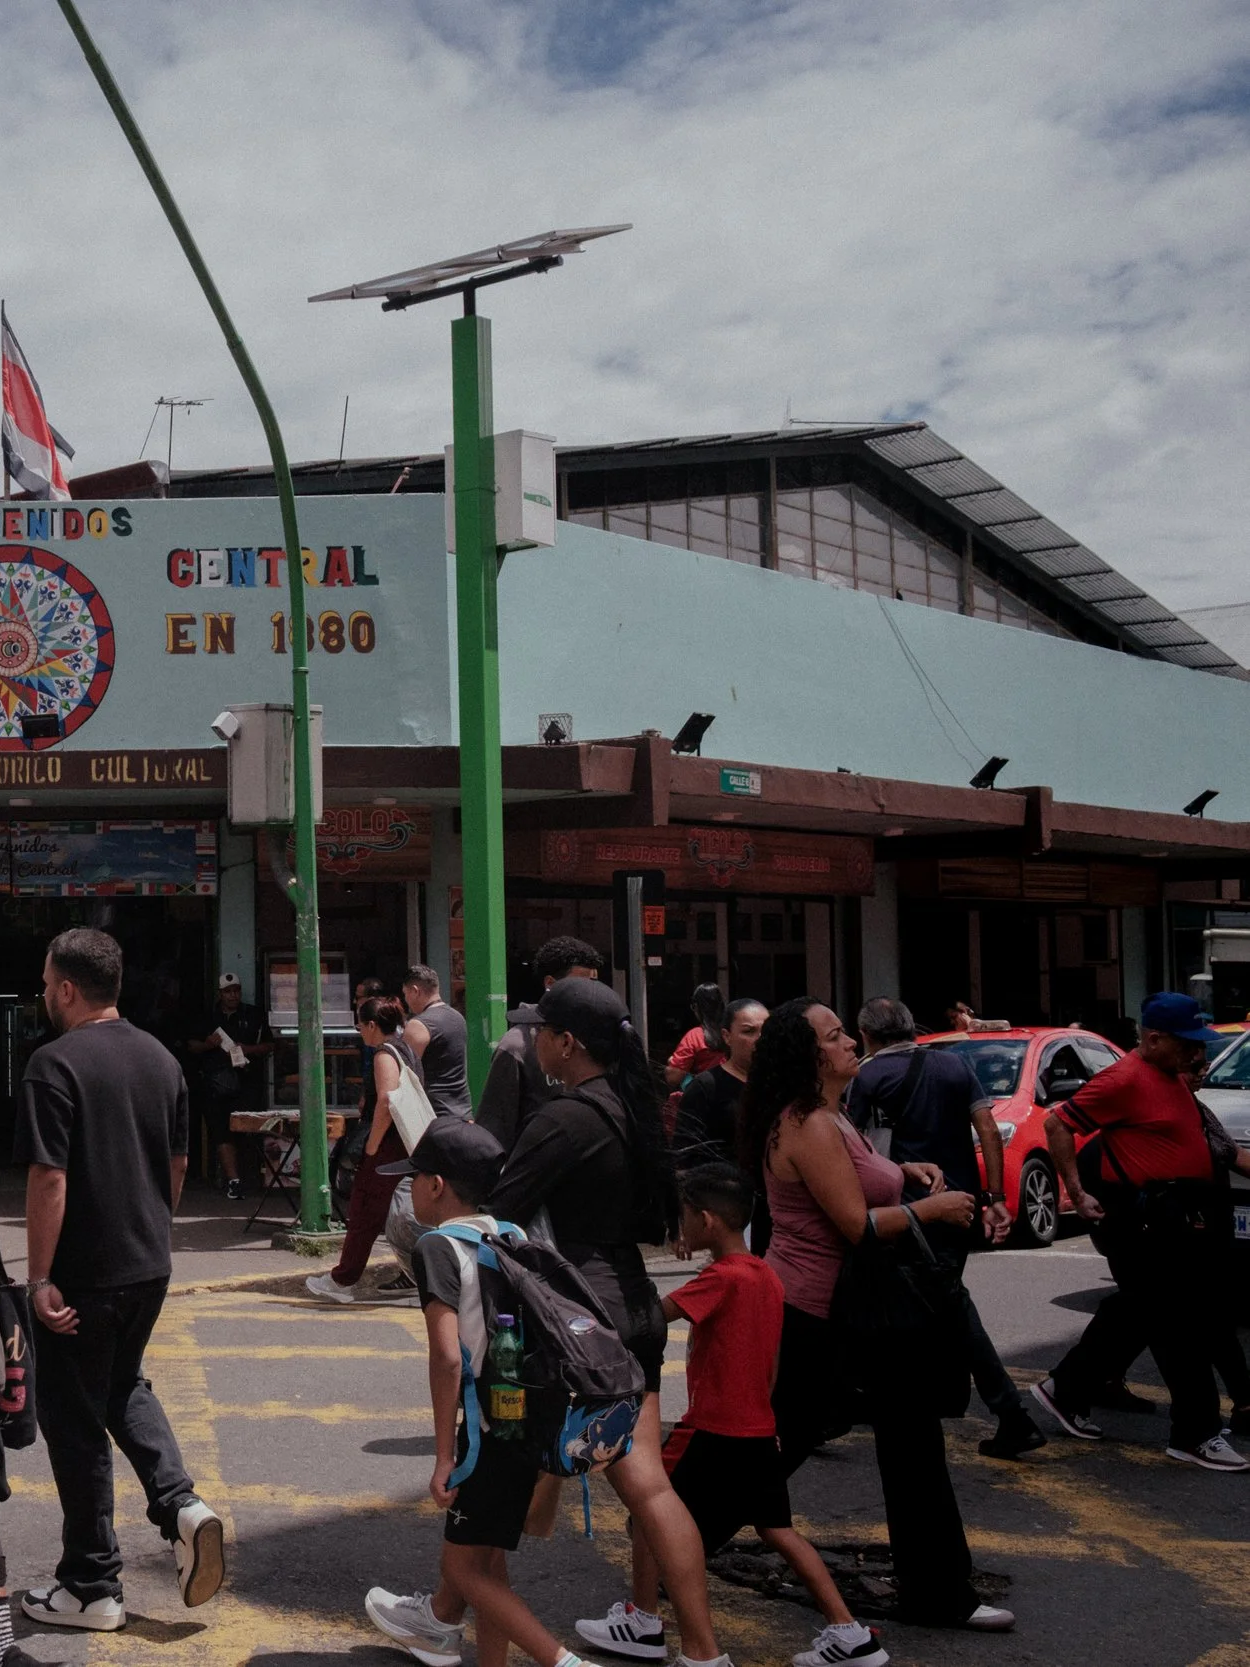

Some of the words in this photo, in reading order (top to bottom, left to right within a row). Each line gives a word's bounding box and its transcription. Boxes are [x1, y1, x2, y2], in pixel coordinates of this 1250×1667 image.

[167, 546, 380, 588] CENTRAL
[165, 612, 236, 654] EN
[271, 610, 376, 654] 1880
[317, 808, 390, 835] COLO
[595, 843, 681, 864] RESTAURANTE
[17, 860, 78, 876] Central
